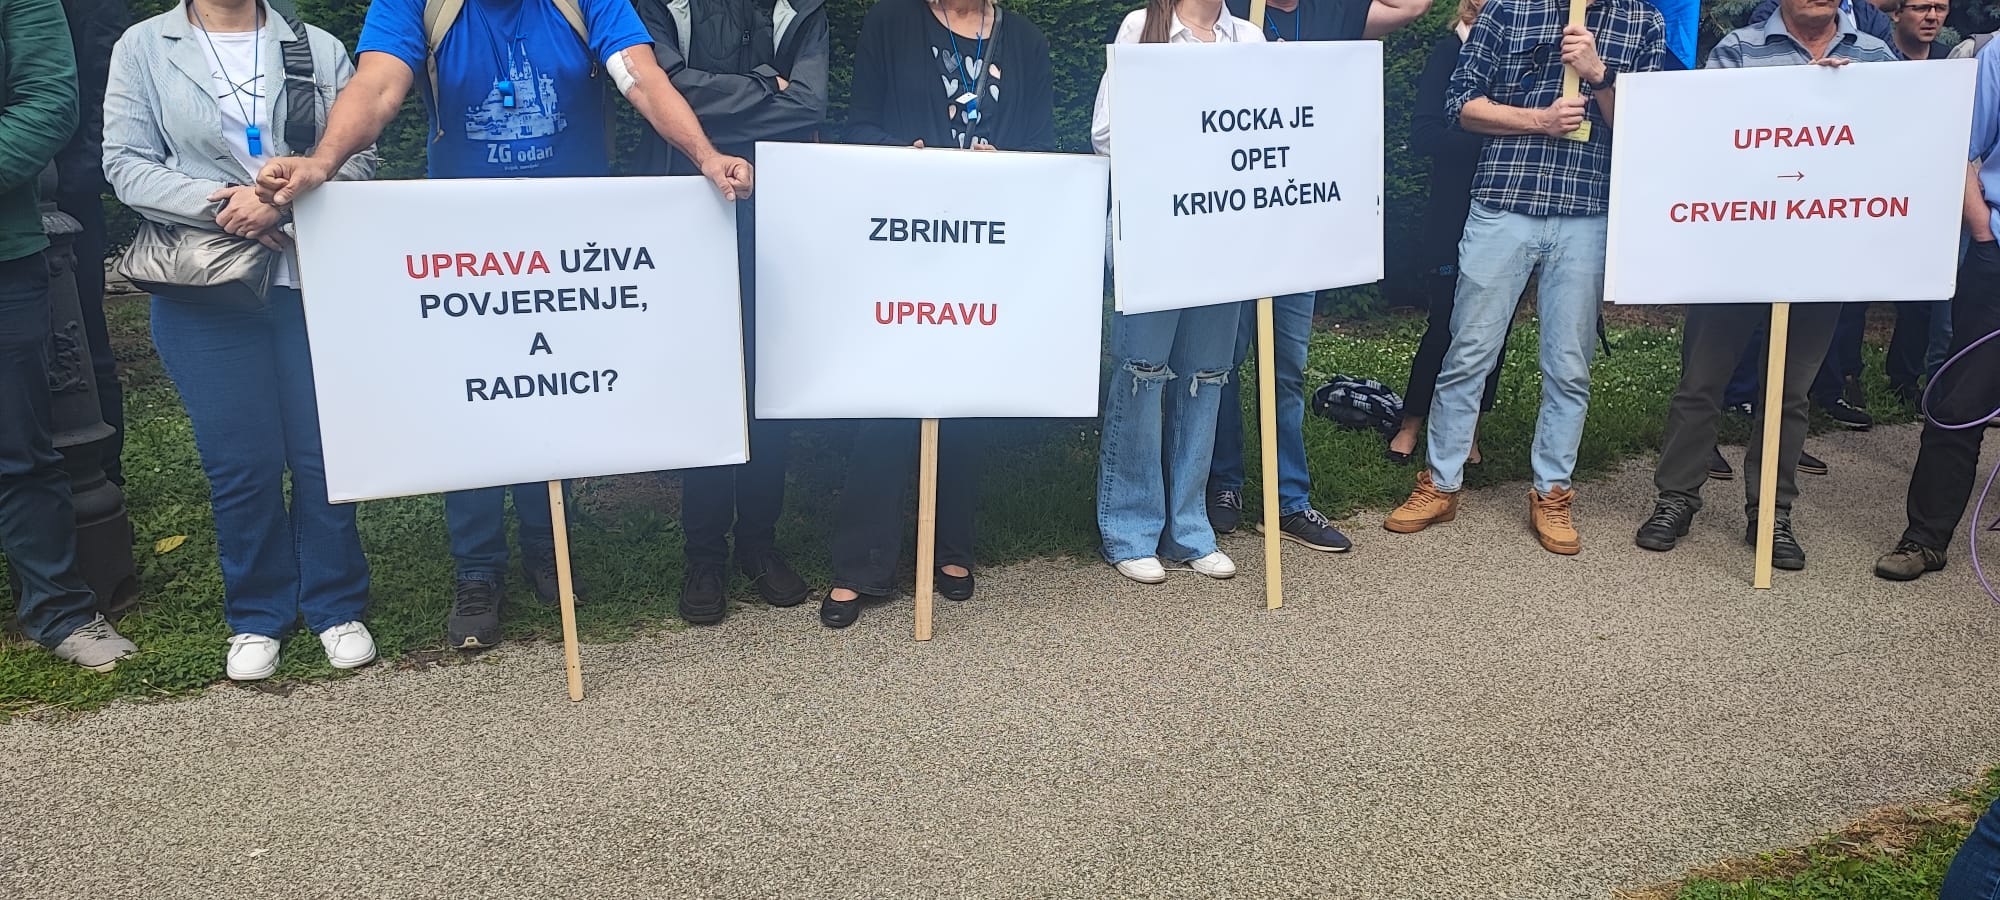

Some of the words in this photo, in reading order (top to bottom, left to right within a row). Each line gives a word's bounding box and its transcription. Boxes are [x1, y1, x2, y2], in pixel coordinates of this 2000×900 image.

[1201, 106, 1284, 133] KOCKA
[1287, 105, 1315, 128] JE
[1734, 124, 1854, 149] UPRAVA
[487, 143, 512, 163] ZG
[517, 145, 554, 162] odan
[1229, 145, 1291, 171] OPET
[1172, 187, 1246, 216] KRIVO
[1252, 177, 1342, 210] BAČENA
[1670, 199, 1777, 222] CRVENI
[1786, 195, 1909, 220] KARTON
[868, 217, 1006, 244] ZBRINITE
[406, 250, 550, 279] UPRAVA
[559, 241, 655, 273] UŽIVA
[419, 285, 649, 318] POVJERENJE,
[874, 301, 997, 325] UPRAVU
[527, 331, 552, 355] A
[465, 369, 619, 401] RADNICI?
